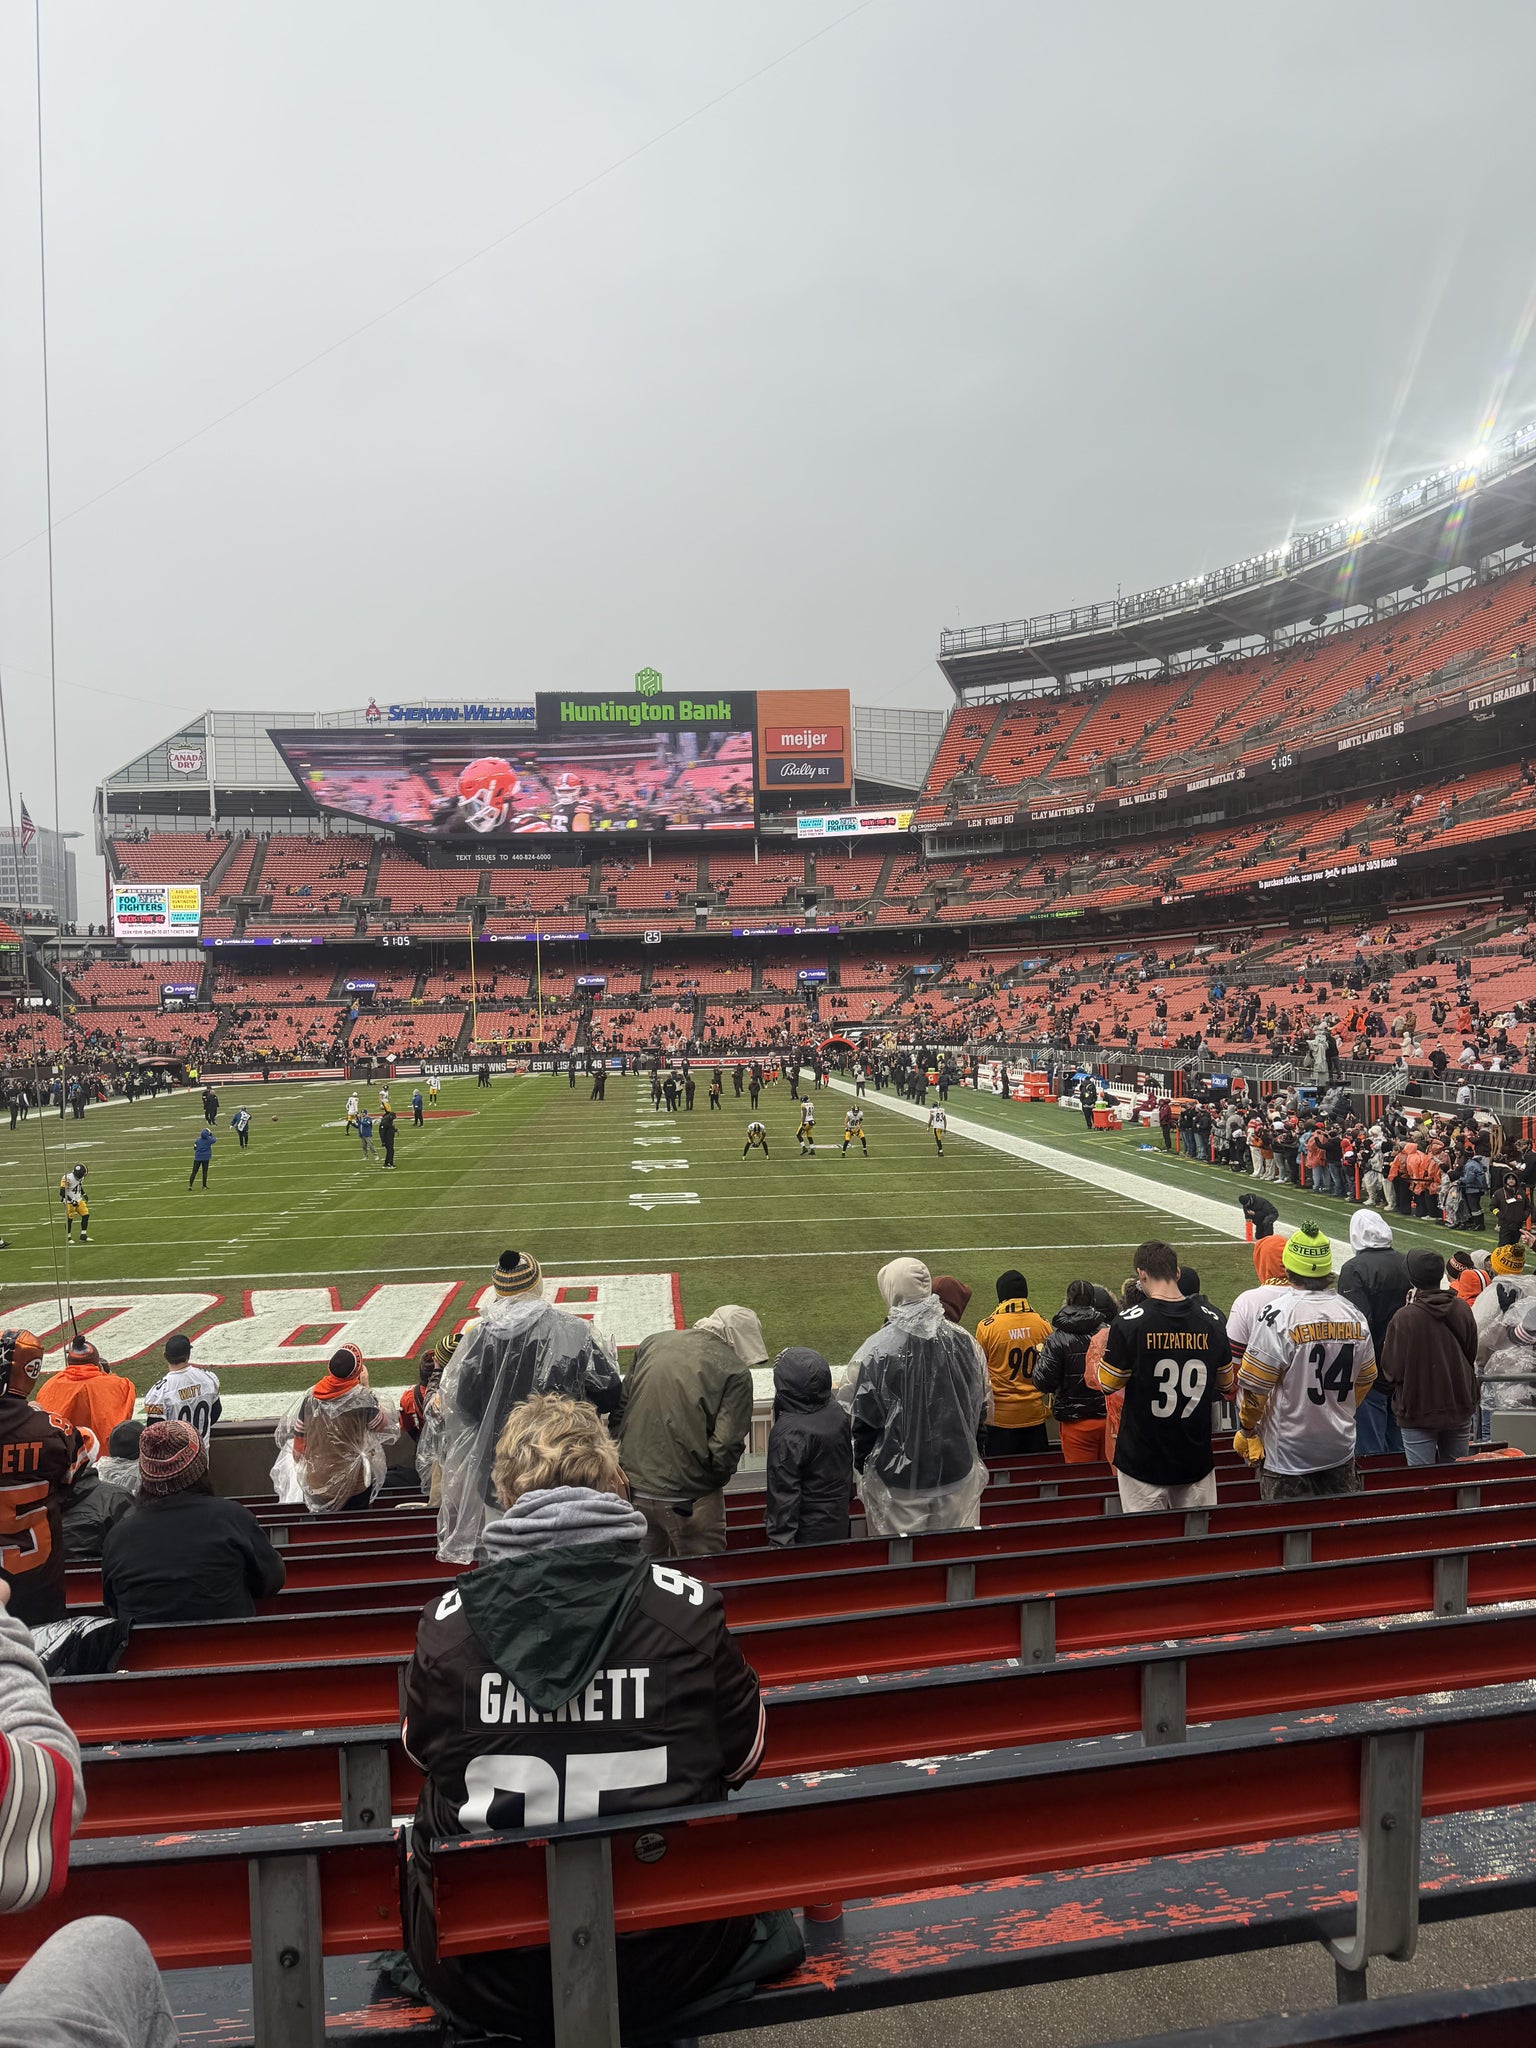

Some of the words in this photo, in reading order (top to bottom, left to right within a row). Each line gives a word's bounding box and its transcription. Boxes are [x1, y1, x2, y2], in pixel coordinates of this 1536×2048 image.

[1469, 694, 1492, 711] OTTO
[1493, 681, 1530, 703] GRAHAM
[388, 704, 535, 721] SHERWIN-WILLIAMS
[560, 701, 676, 727] Huntington
[679, 700, 732, 721] Bank
[780, 730, 828, 748] meijer
[1338, 735, 1361, 751] DANTE
[1362, 726, 1392, 743] LAVELLI
[1393, 721, 1405, 735] 86
[168, 754, 204, 762] CANADA
[780, 762, 816, 779] Bally
[817, 767, 830, 776] BET
[1236, 768, 1245, 779] 36
[1119, 797, 1133, 807] BILL
[1134, 792, 1157, 805] WILLIS
[1158, 789, 1168, 799] 60
[1031, 812, 1048, 820] CLAY
[1049, 805, 1084, 818] MATTHEWS
[1086, 803, 1096, 813] 57
[968, 819, 982, 828] LEN
[985, 817, 1003, 826] FORD
[1004, 815, 1014, 824] 80
[1264, 878, 1284, 890] purchase
[1301, 873, 1313, 882] scan
[1313, 871, 1324, 882] your
[1347, 864, 1358, 874] look
[1358, 863, 1366, 872] for
[1381, 857, 1397, 868] Kiosks
[120, 896, 137, 904] FOO
[120, 903, 163, 911] FIGHTERS
[647, 932, 660, 942] 25
[424, 1062, 470, 1074] CLEVELAND
[472, 1062, 507, 1072] BRWNS
[1107, 1113, 1114, 1123] G
[1258, 1304, 1281, 1328] 34
[1008, 1327, 1031, 1340] WATT
[1147, 1332, 1209, 1350] FITZPATRICK
[1008, 1346, 1037, 1381] 90
[1307, 1343, 1355, 1406] 34
[178, 1384, 202, 1401] WATT
[1151, 1358, 1208, 1419] 39
